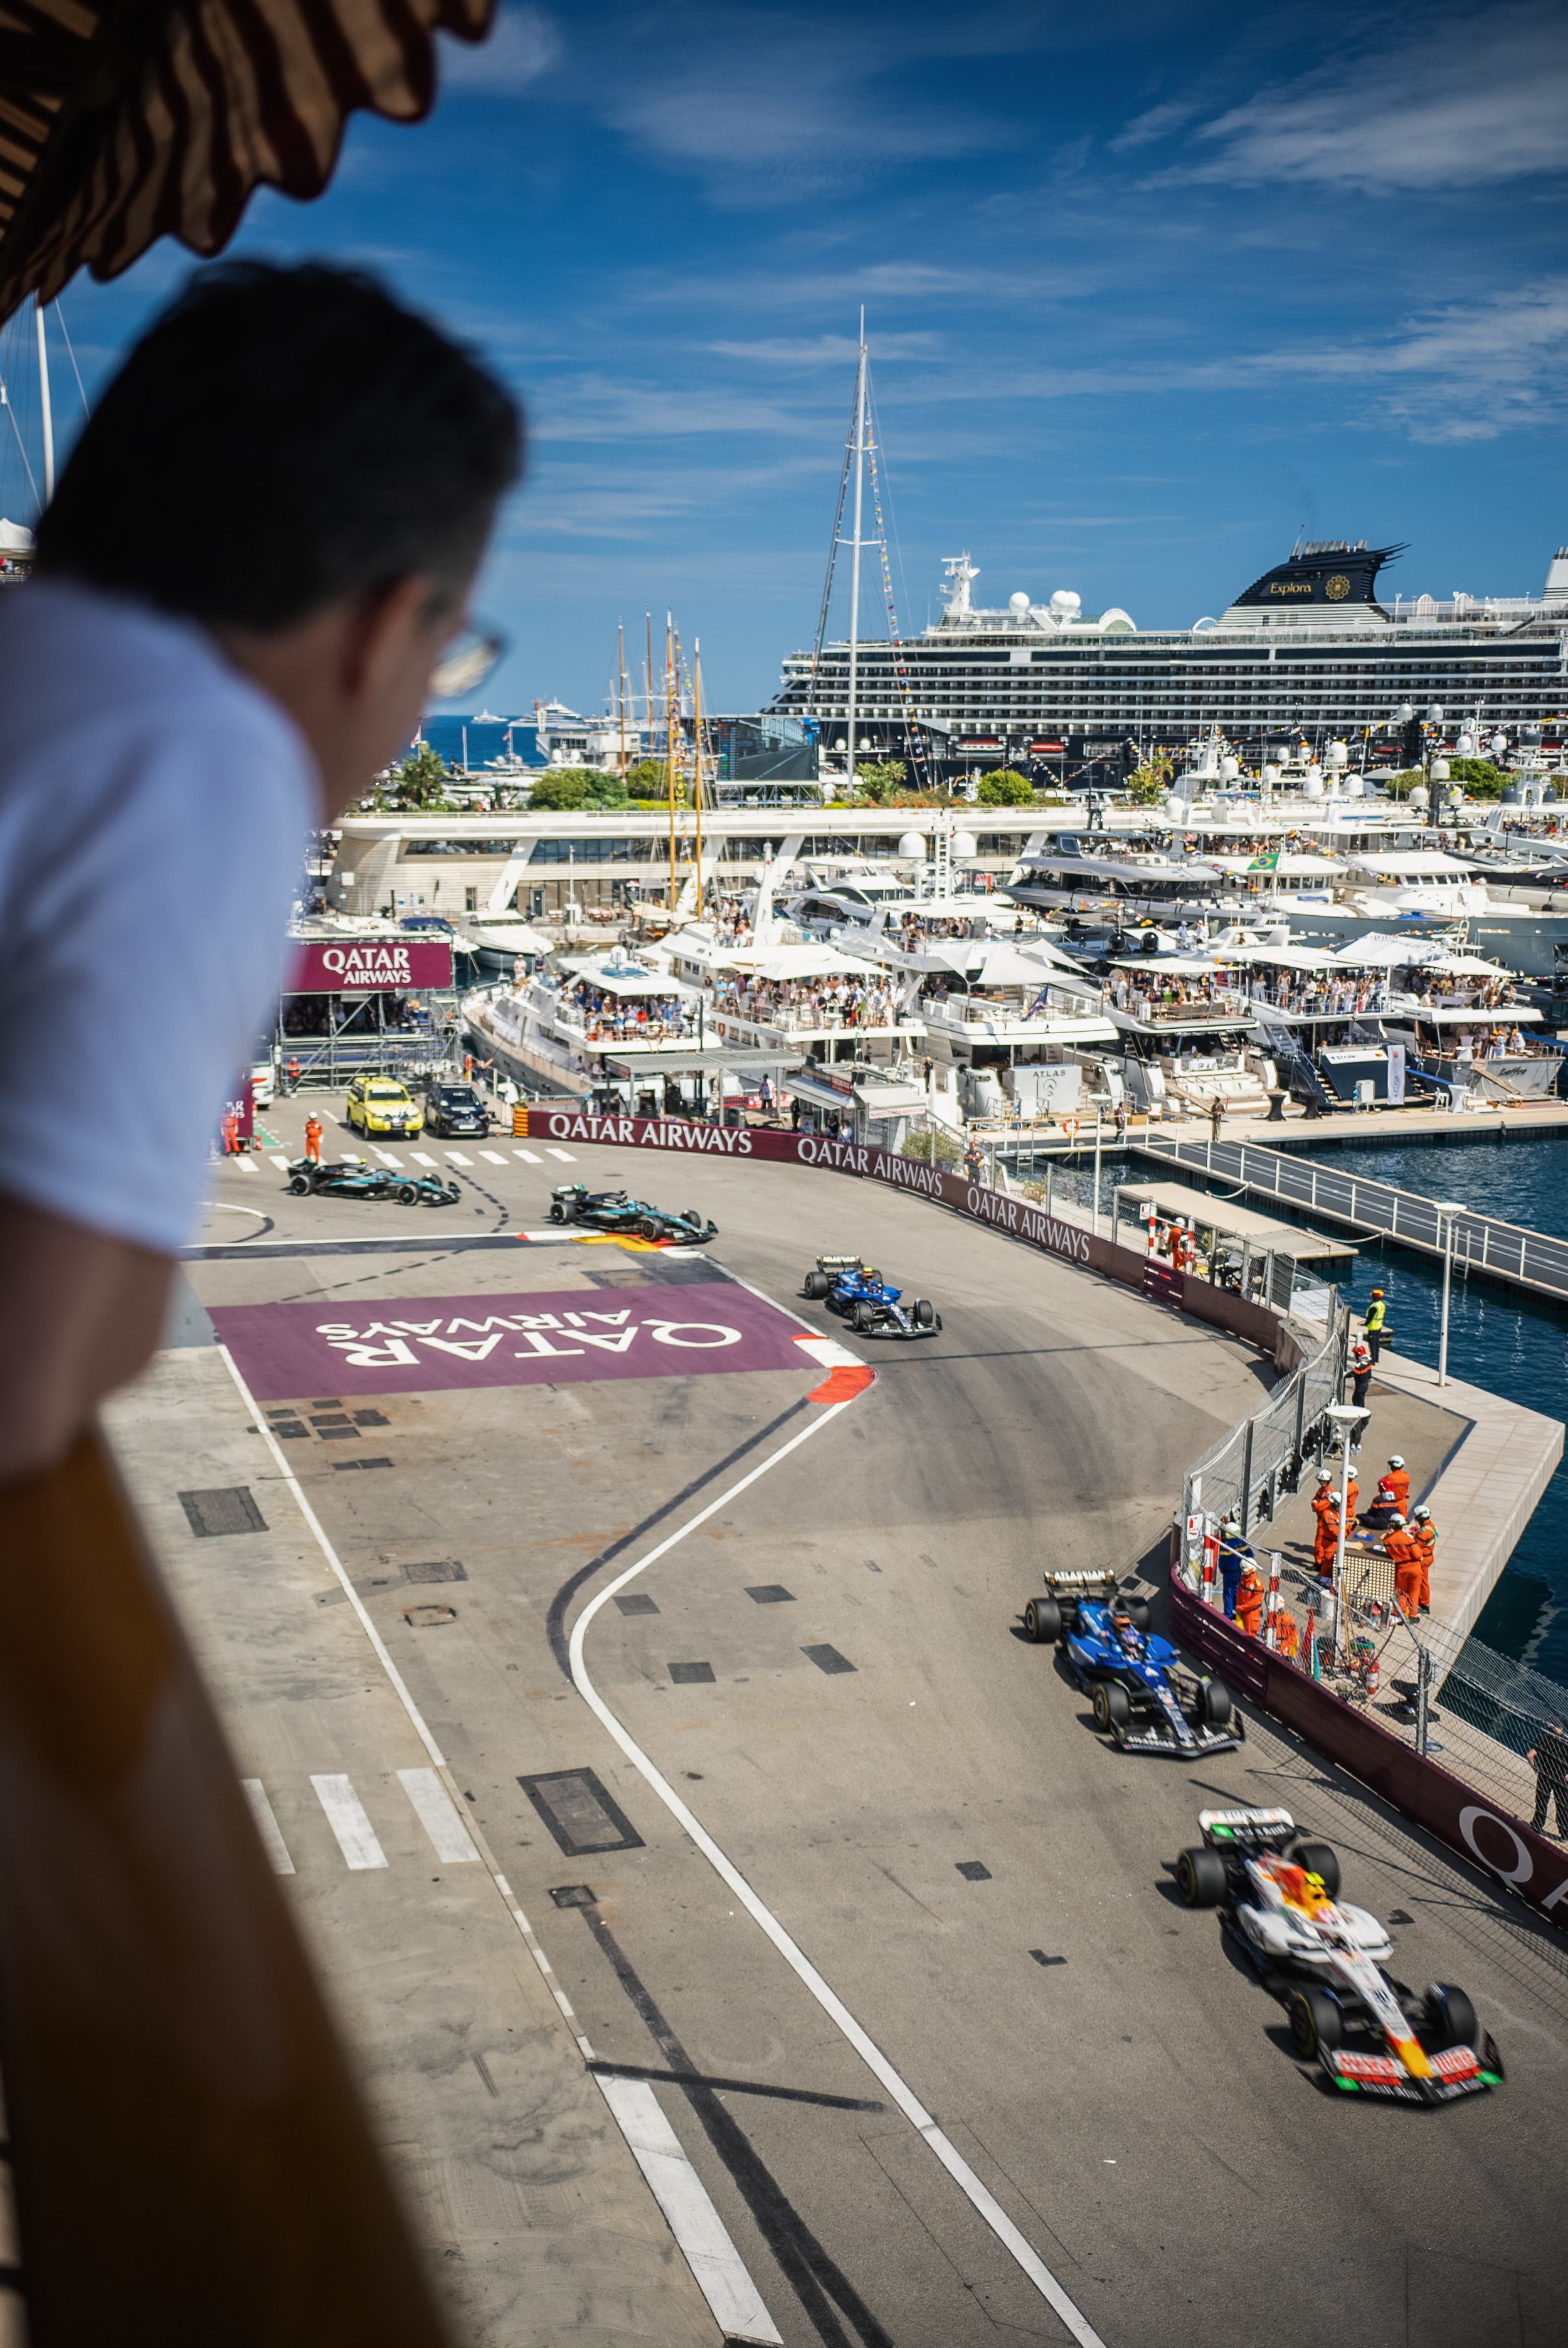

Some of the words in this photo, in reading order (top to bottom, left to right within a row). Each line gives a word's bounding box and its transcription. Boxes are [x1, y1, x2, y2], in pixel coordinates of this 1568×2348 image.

[1270, 582, 1311, 596] Explora
[322, 947, 410, 974] QATAR
[343, 969, 411, 985] AIRWAYS
[1032, 1069, 1066, 1078] ATLAS
[549, 1113, 635, 1144] QATAR
[640, 1121, 752, 1154] AIRWAYS
[797, 1137, 869, 1173] QATAR
[873, 1153, 943, 1196] AIRWAYS
[967, 1186, 1017, 1231] QATAR
[1020, 1213, 1090, 1262] AIRWAYS
[315, 1309, 632, 1341] AIRWAYS
[327, 1318, 743, 1368] QATAR
[1054, 1570, 1106, 1581] ATLASSIAN
